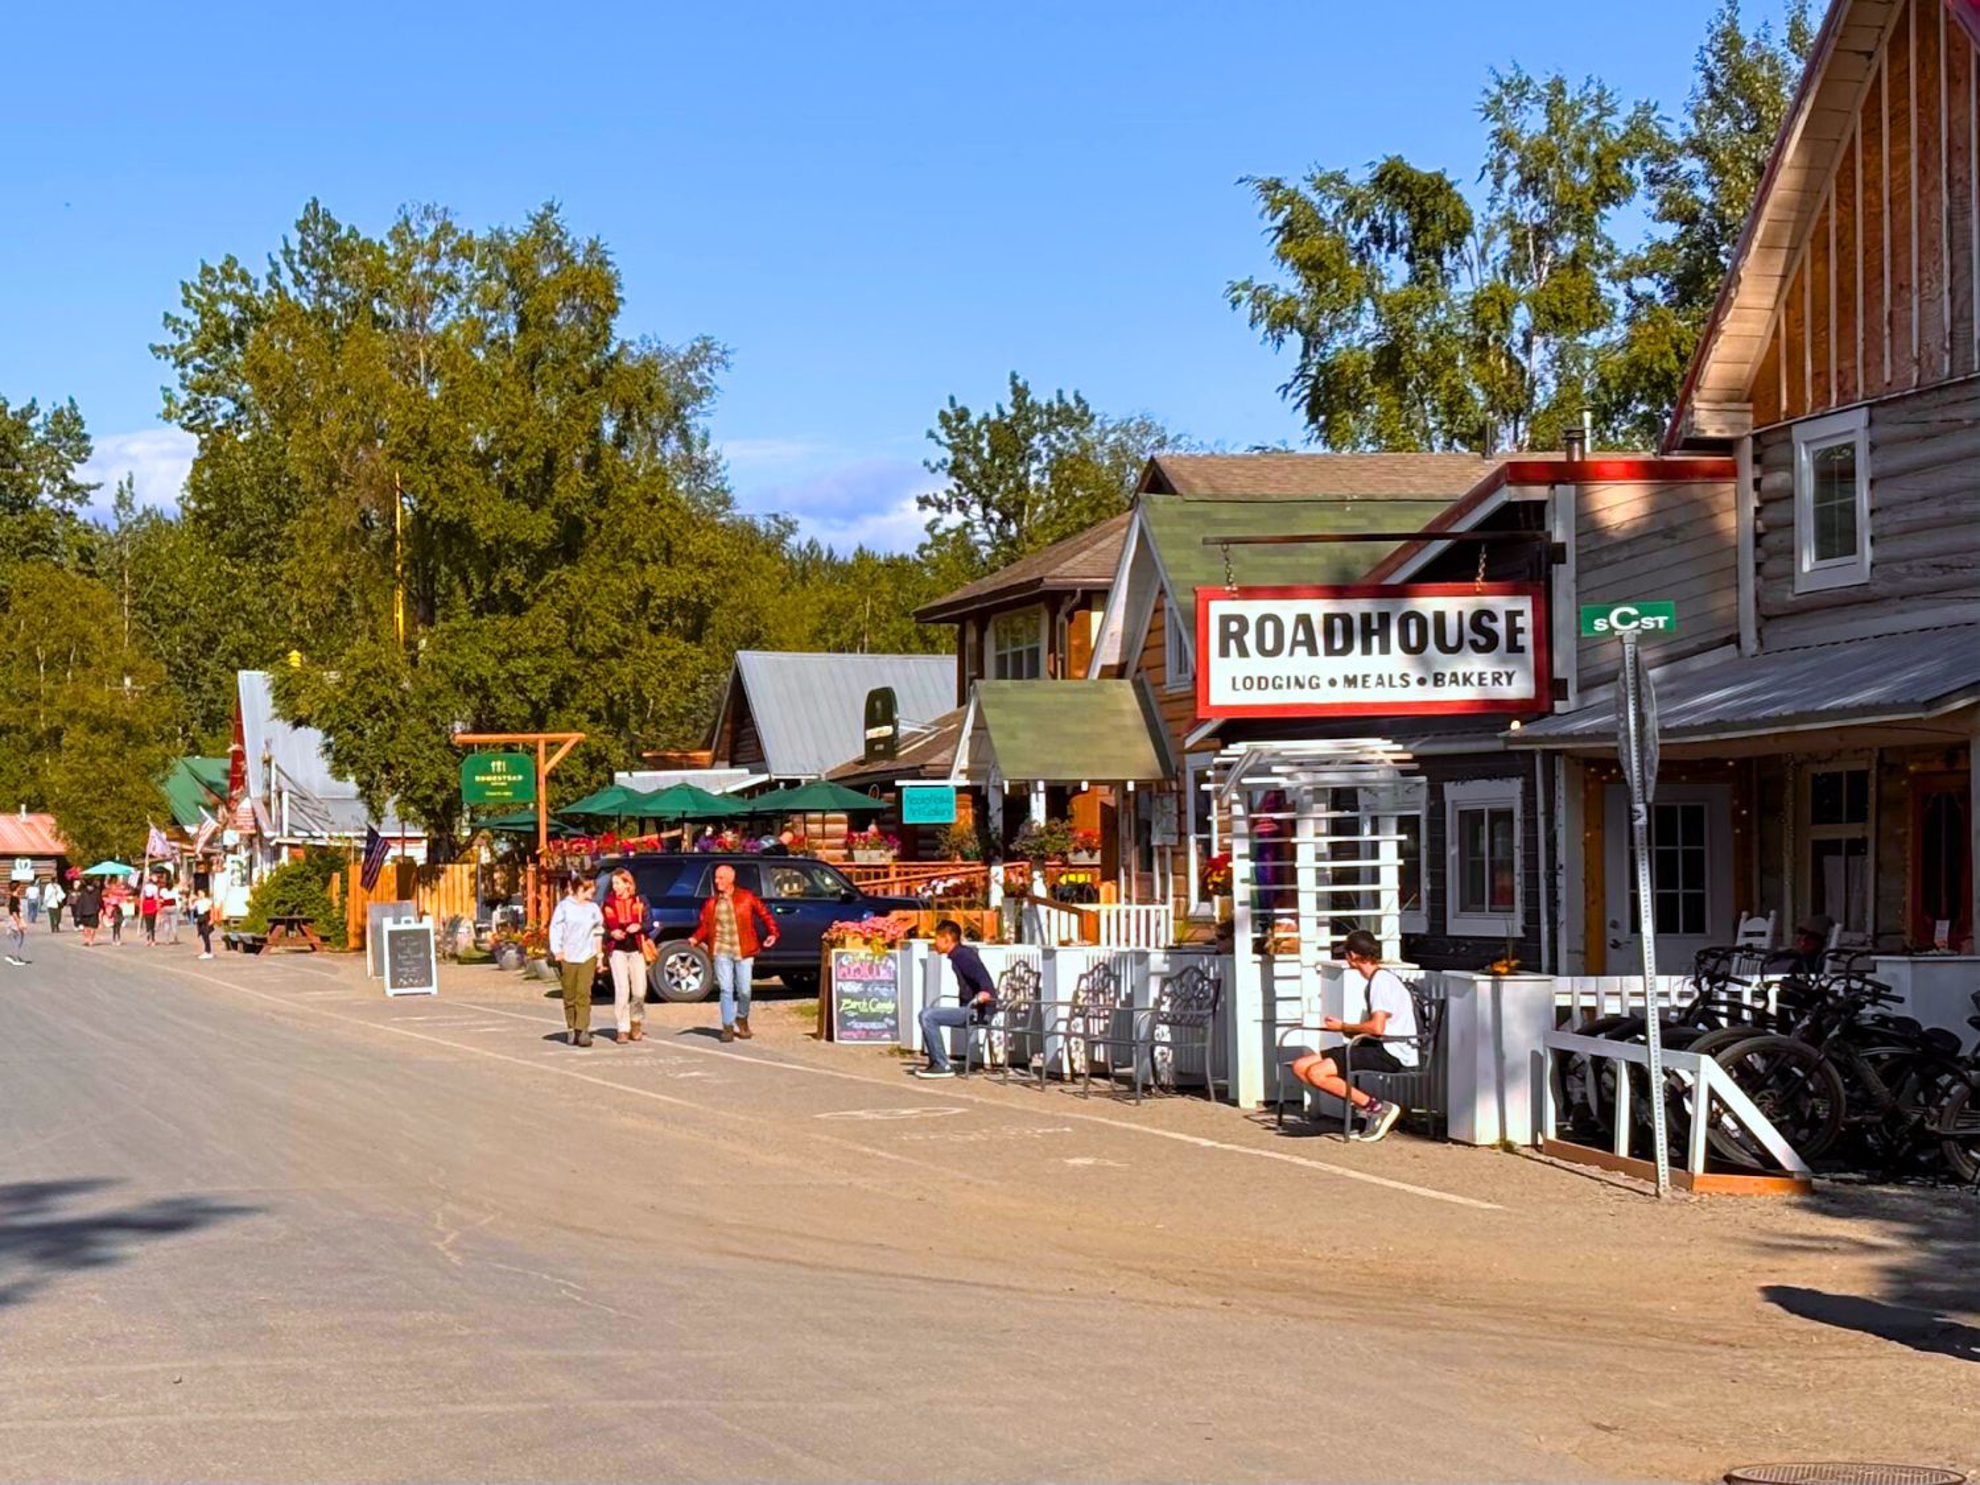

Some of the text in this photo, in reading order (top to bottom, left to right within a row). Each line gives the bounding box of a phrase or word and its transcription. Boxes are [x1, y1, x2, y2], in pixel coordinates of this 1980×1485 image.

[1217, 609, 1525, 659] ROADHOUSE
[1231, 669, 1517, 692] LODGING MEALS BAKERY
